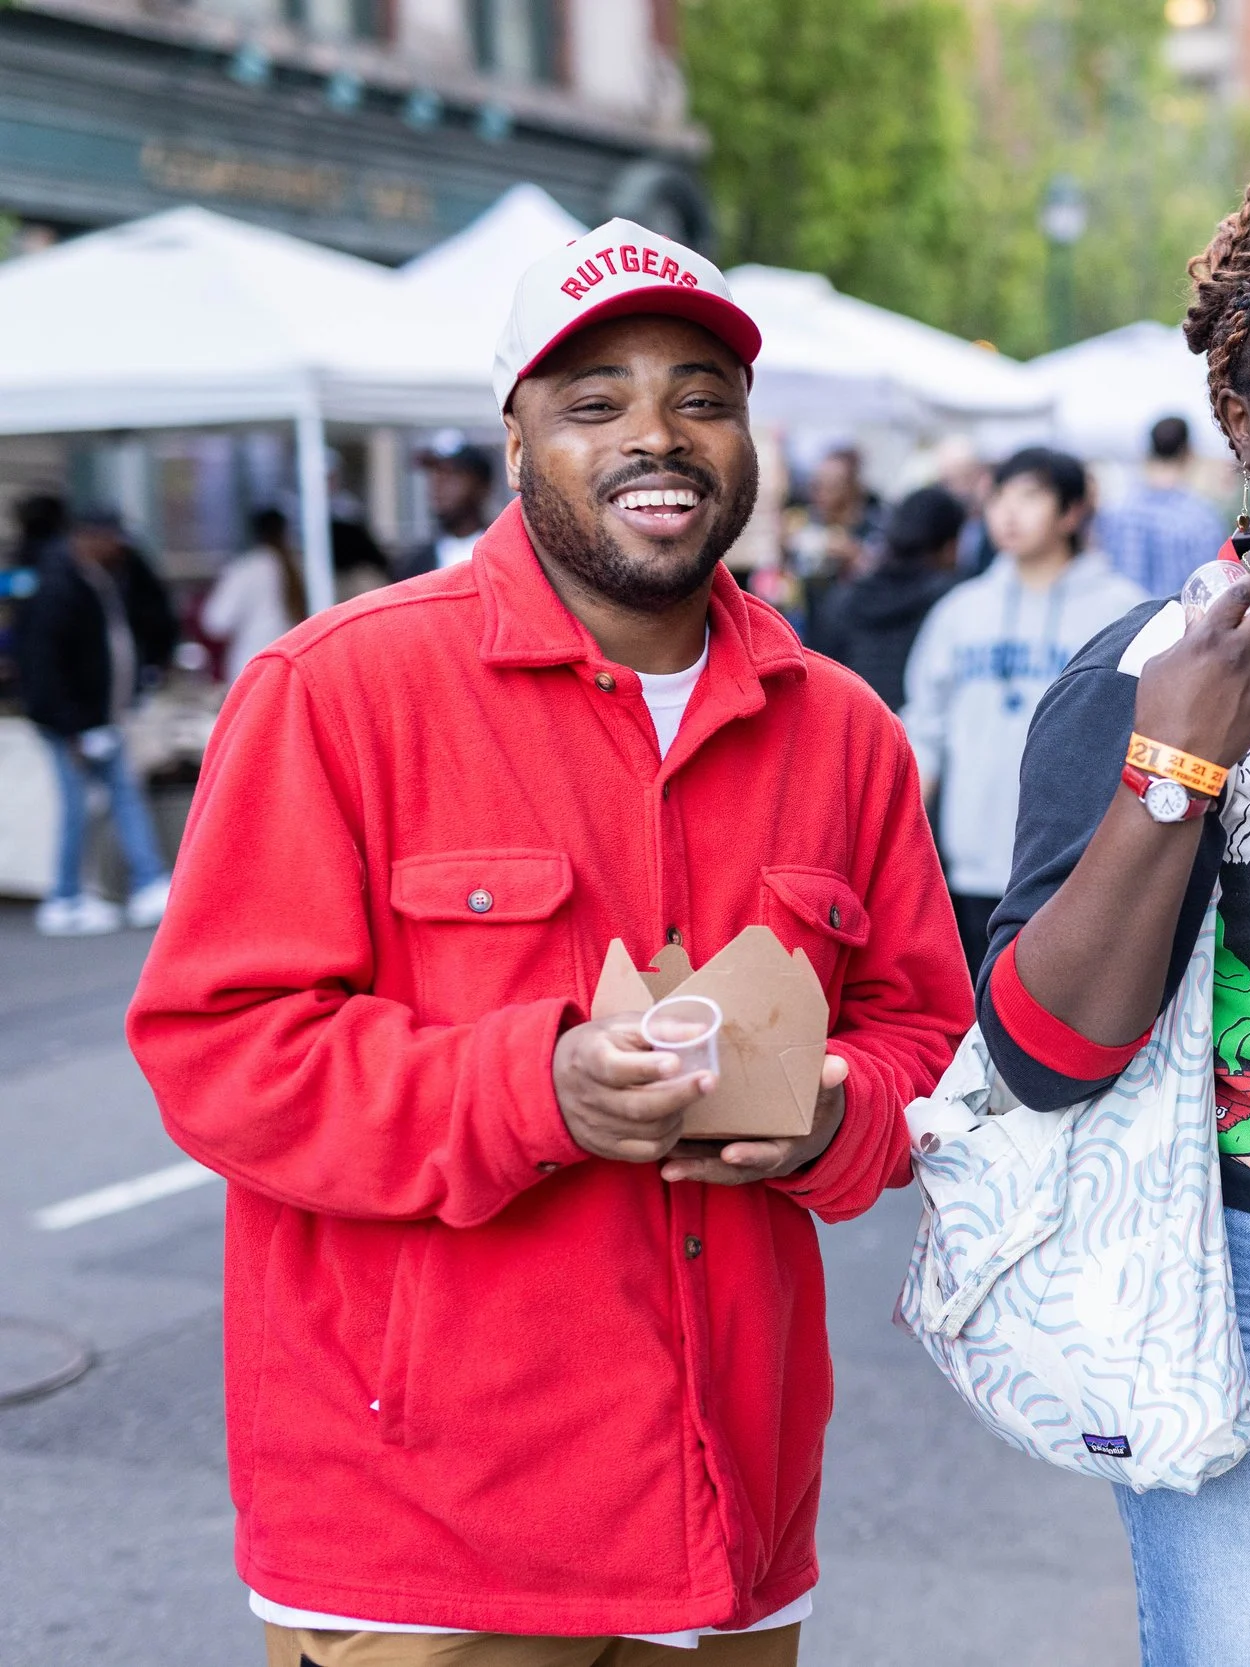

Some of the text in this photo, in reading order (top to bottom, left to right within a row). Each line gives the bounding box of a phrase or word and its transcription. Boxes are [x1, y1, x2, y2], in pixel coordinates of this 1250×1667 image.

[560, 245, 698, 300] RUTGERS
[1131, 742, 1161, 768] 21
[1168, 754, 1185, 768] 21
[1191, 763, 1206, 777] 21
[1212, 771, 1223, 783] 21
